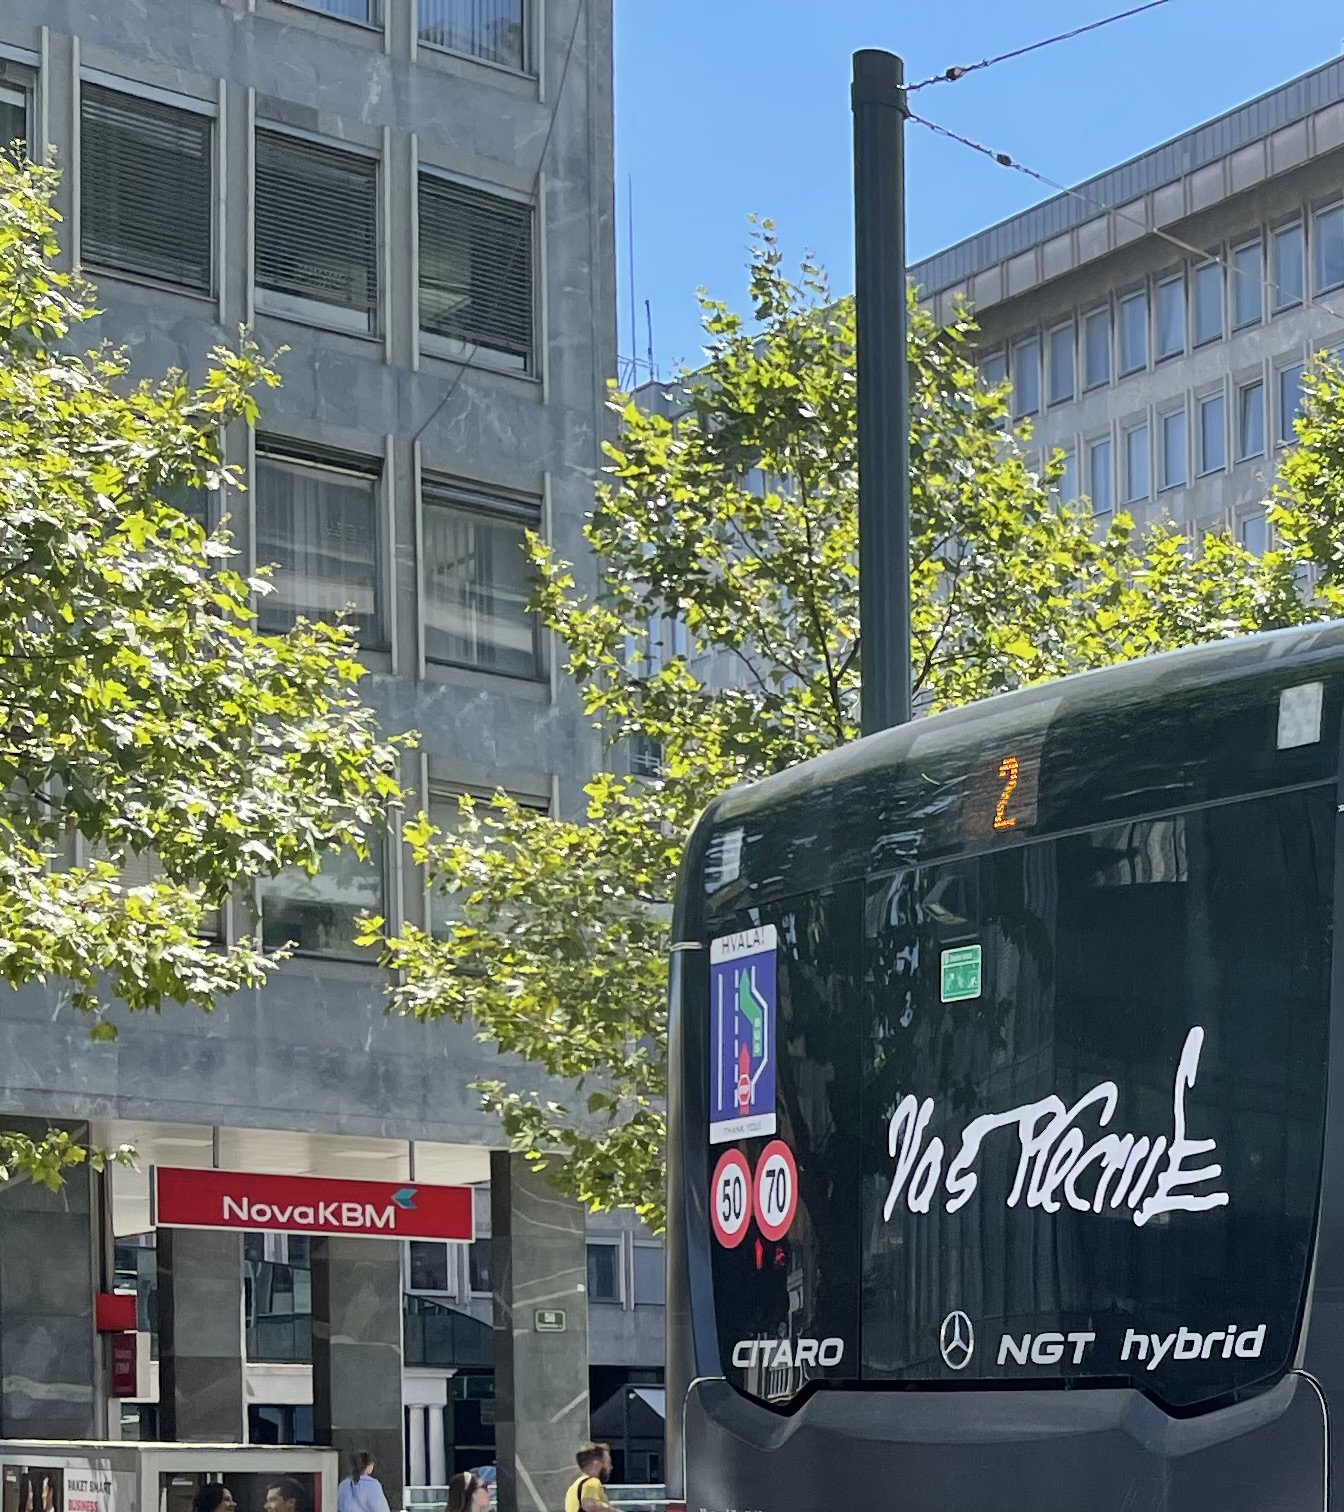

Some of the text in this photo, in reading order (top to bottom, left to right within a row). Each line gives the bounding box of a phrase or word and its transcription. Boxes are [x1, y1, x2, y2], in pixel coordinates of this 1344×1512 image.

[993, 756, 1019, 829] 2
[722, 930, 765, 954] HVALA!
[724, 1124, 746, 1134] THANK
[223, 1195, 396, 1230] NovaKBM
[722, 1176, 742, 1222] 50
[766, 1168, 786, 1214] 70
[732, 1324, 1267, 1370] CITARO NGT hybrid
